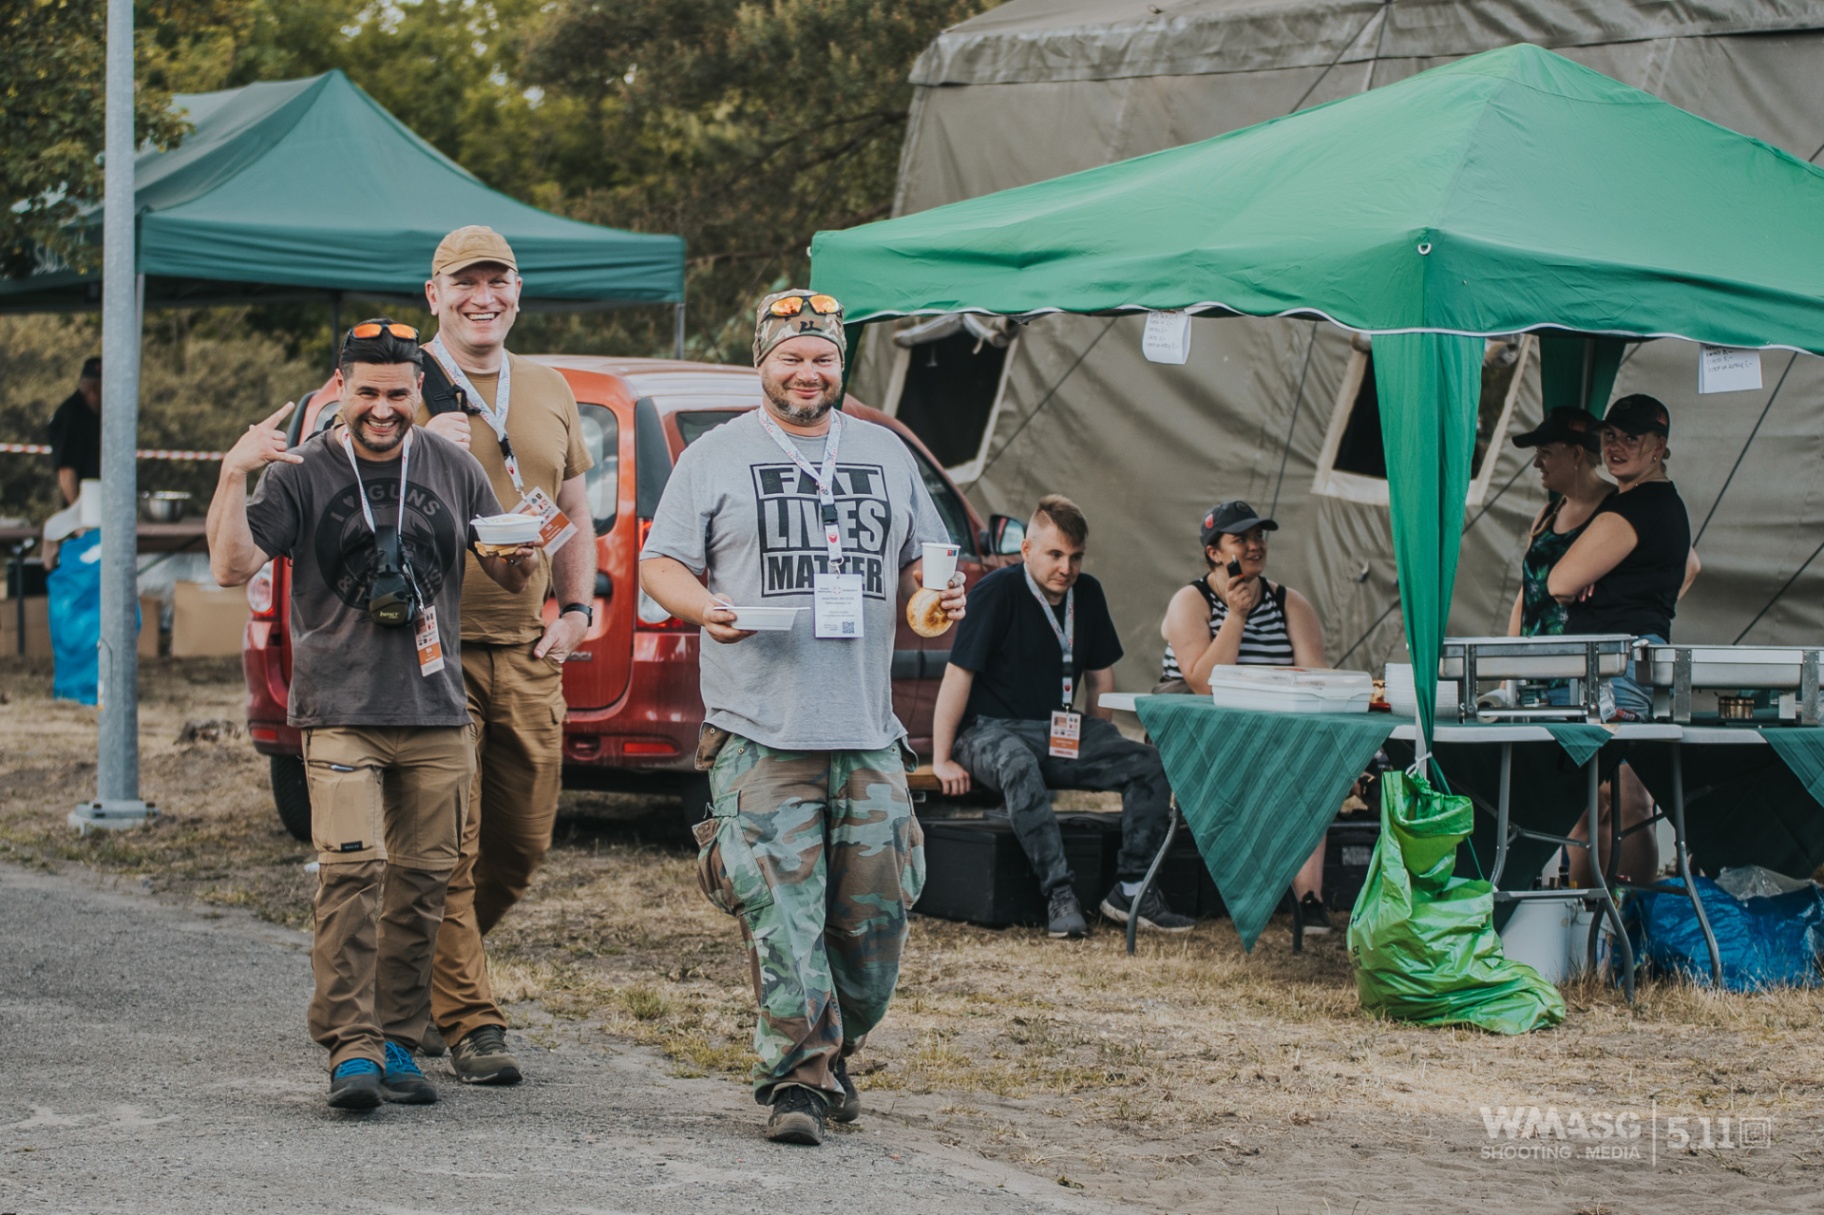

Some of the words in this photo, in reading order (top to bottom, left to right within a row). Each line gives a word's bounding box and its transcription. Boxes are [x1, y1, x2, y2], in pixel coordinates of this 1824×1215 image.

[759, 467, 879, 495] FAT
[367, 484, 441, 516] GUNS
[763, 499, 886, 552] LIVES
[767, 555, 883, 593] MATTER
